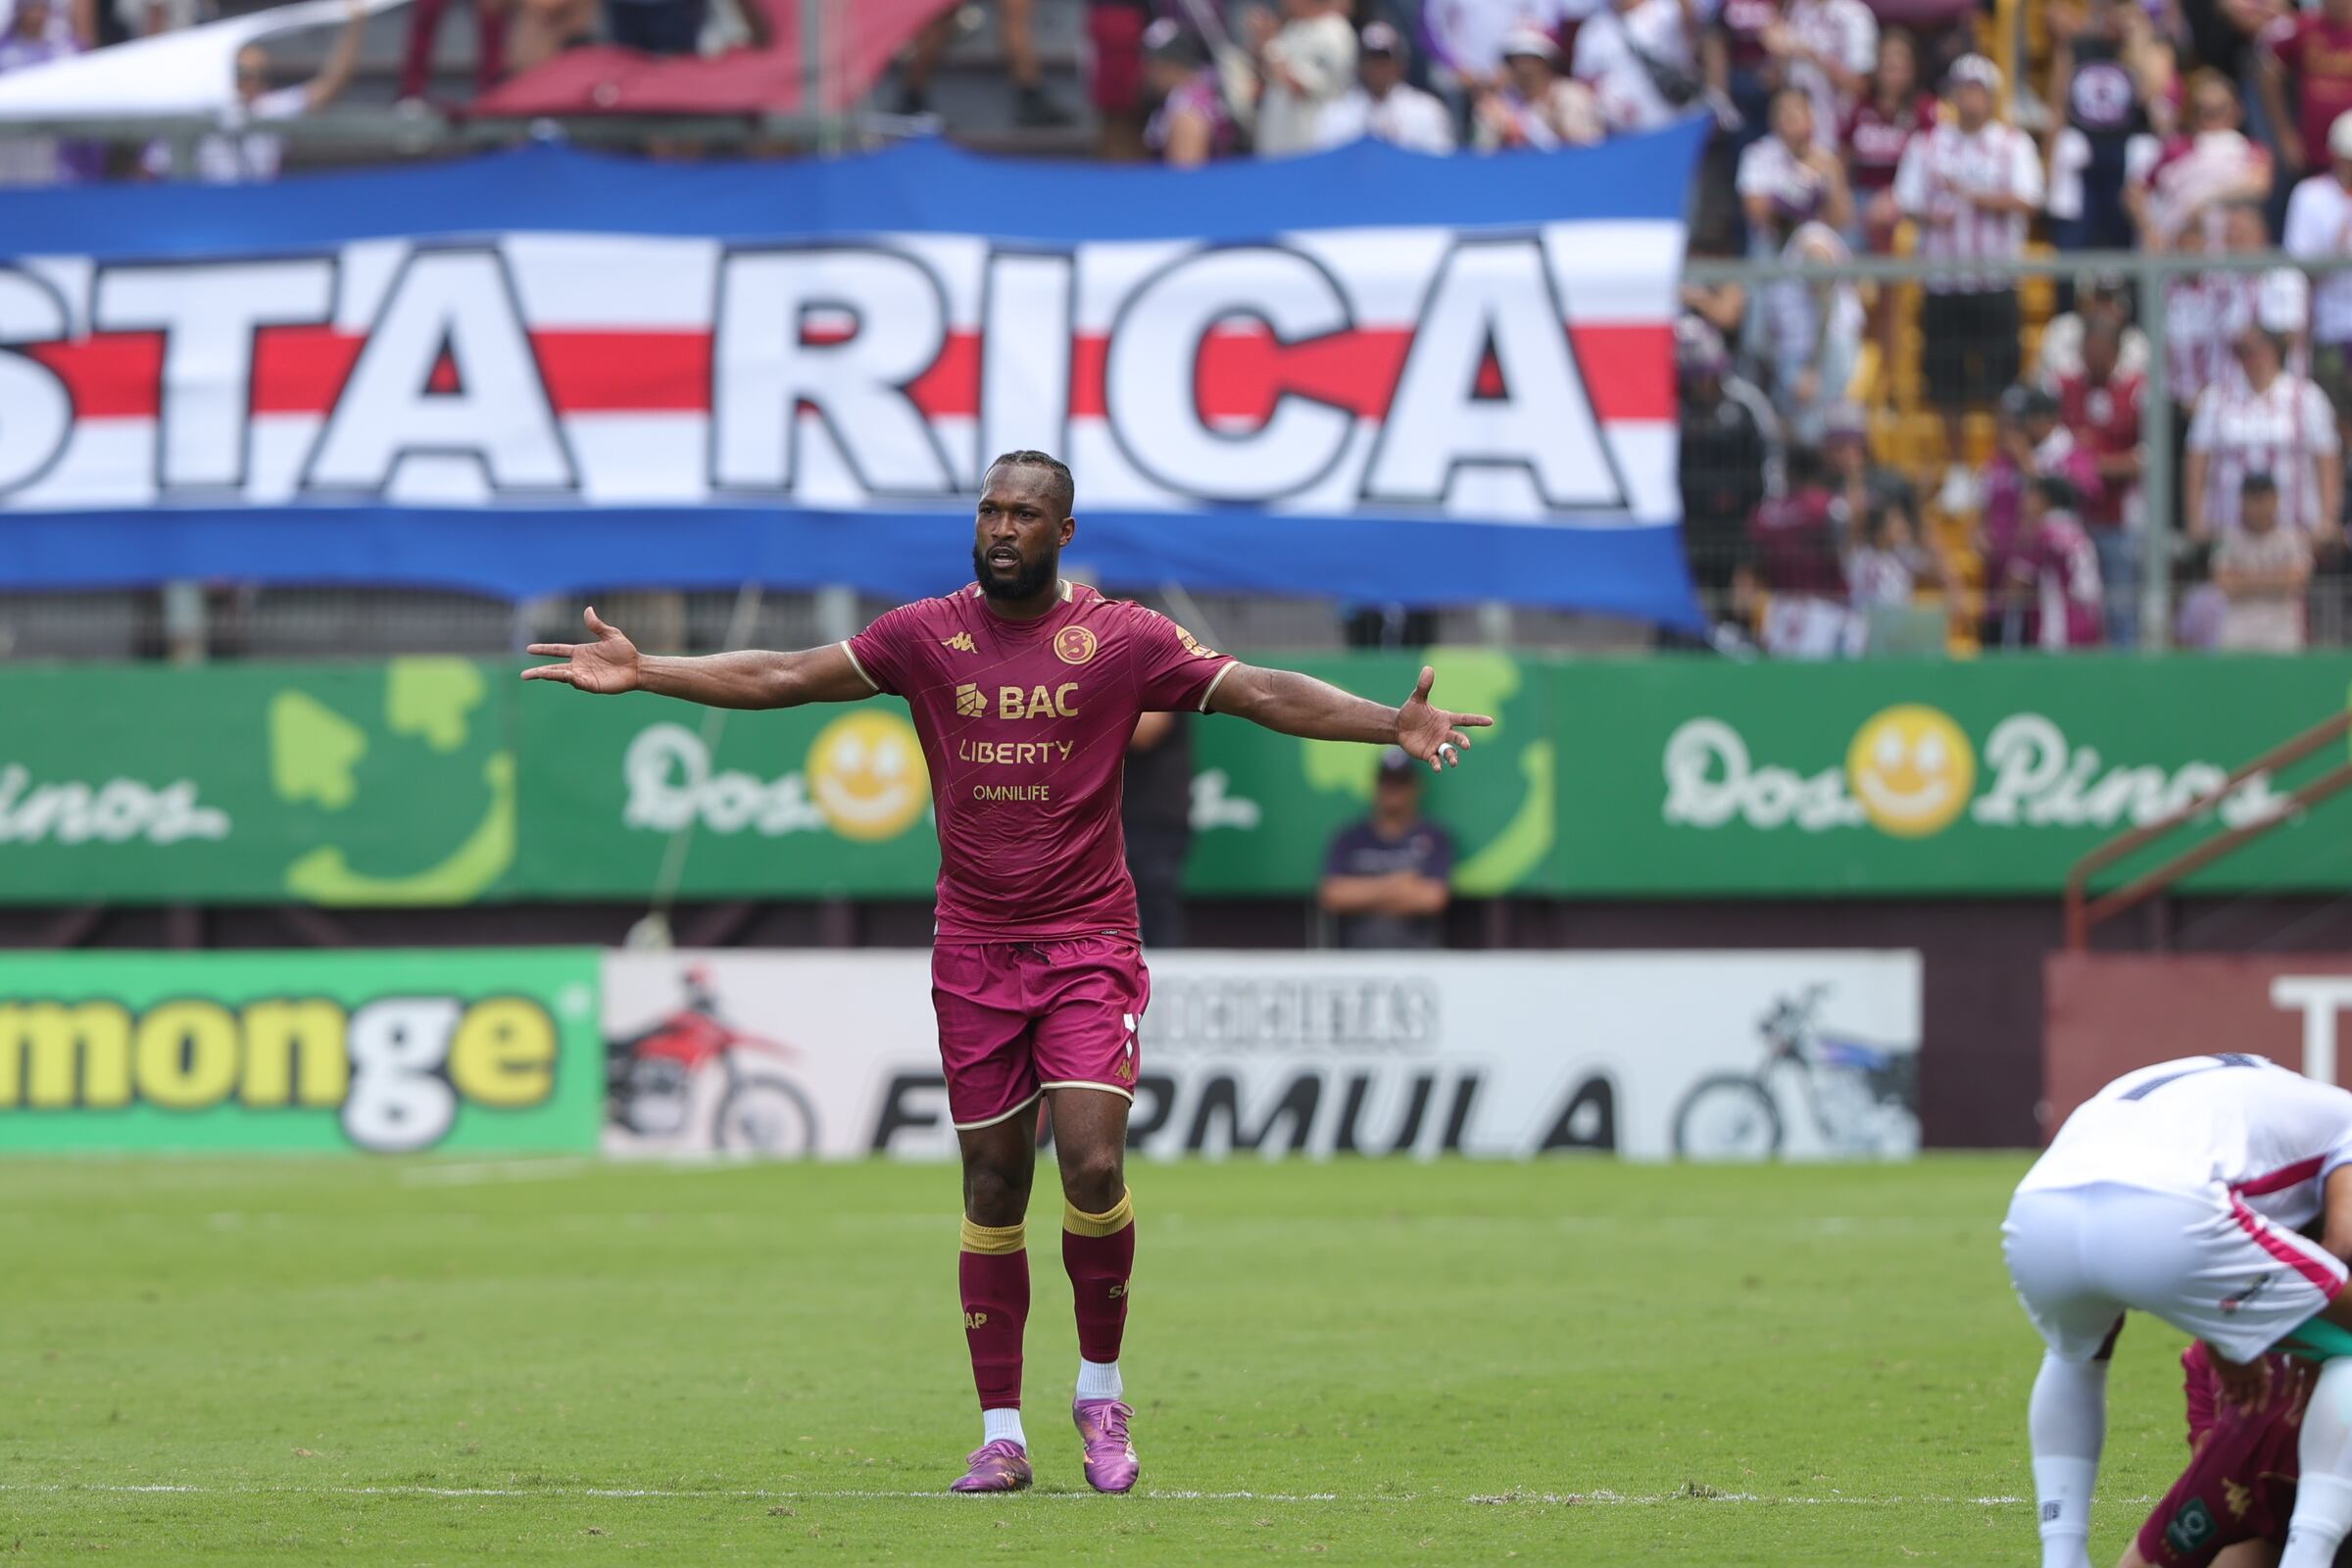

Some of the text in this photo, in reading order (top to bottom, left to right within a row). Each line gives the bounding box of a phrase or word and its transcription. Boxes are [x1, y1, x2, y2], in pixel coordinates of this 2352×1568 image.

[710, 232, 1627, 508] RICA
[958, 739, 1074, 764] LIBERTY
[1000, 682, 1079, 719] BAC
[622, 722, 828, 836] Dos
[973, 785, 1050, 802] OMNILIFE
[1662, 716, 1865, 831] Dos
[0, 994, 559, 1153] monge
